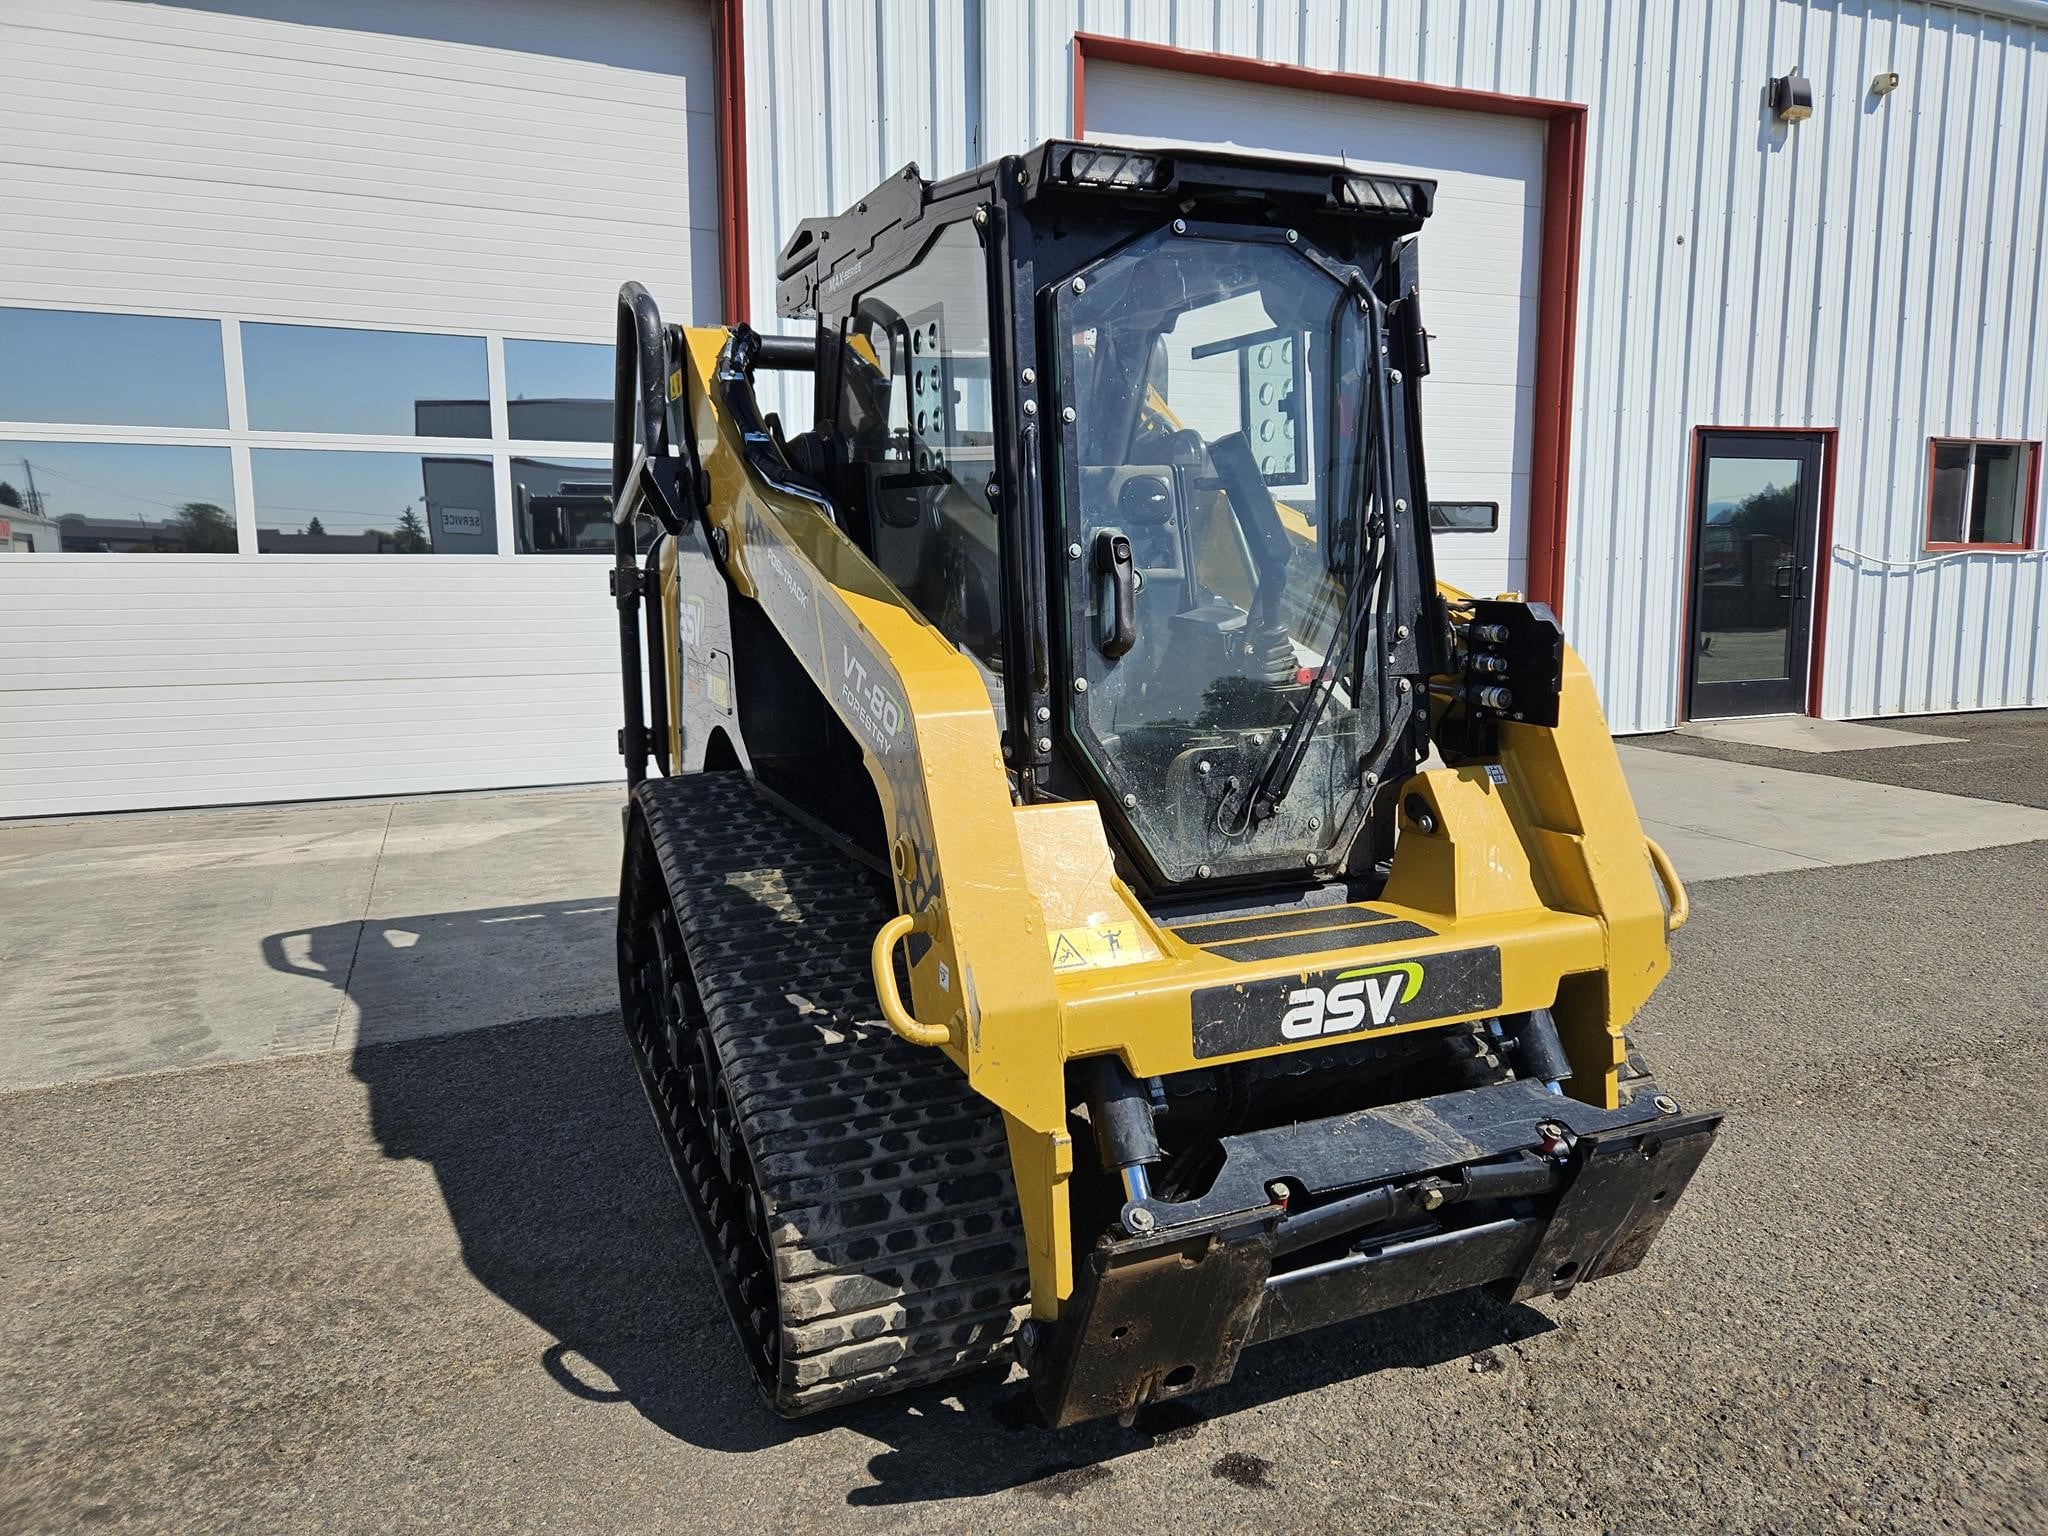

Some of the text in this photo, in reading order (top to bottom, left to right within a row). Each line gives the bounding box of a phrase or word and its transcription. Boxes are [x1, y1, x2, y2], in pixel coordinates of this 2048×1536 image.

[767, 548, 808, 609] POSI-TRACK
[842, 645, 898, 737] VT-80
[842, 683, 892, 755] FORESTRY
